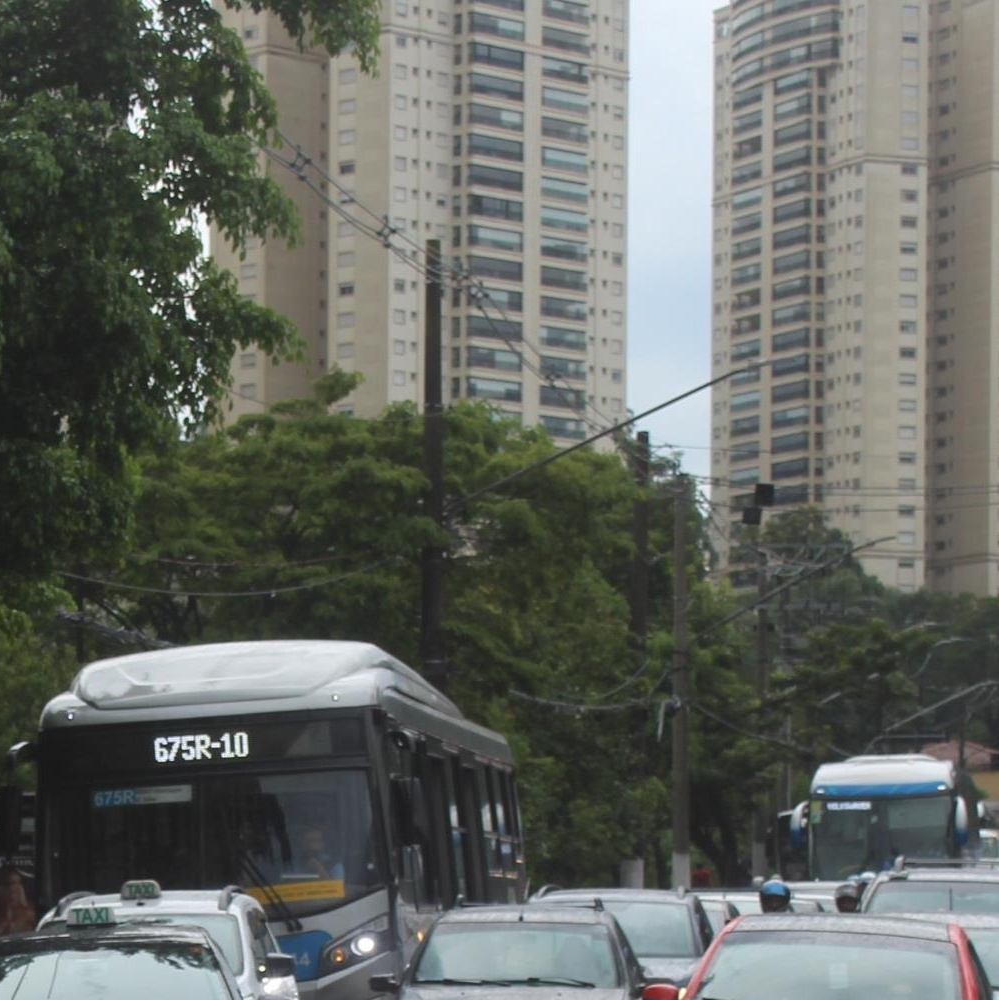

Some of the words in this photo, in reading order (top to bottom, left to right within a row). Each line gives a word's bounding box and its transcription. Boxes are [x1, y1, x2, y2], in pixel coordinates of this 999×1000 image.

[153, 731, 250, 763] 675R-10
[126, 883, 155, 897] TAXI
[71, 907, 110, 923] TAXI
